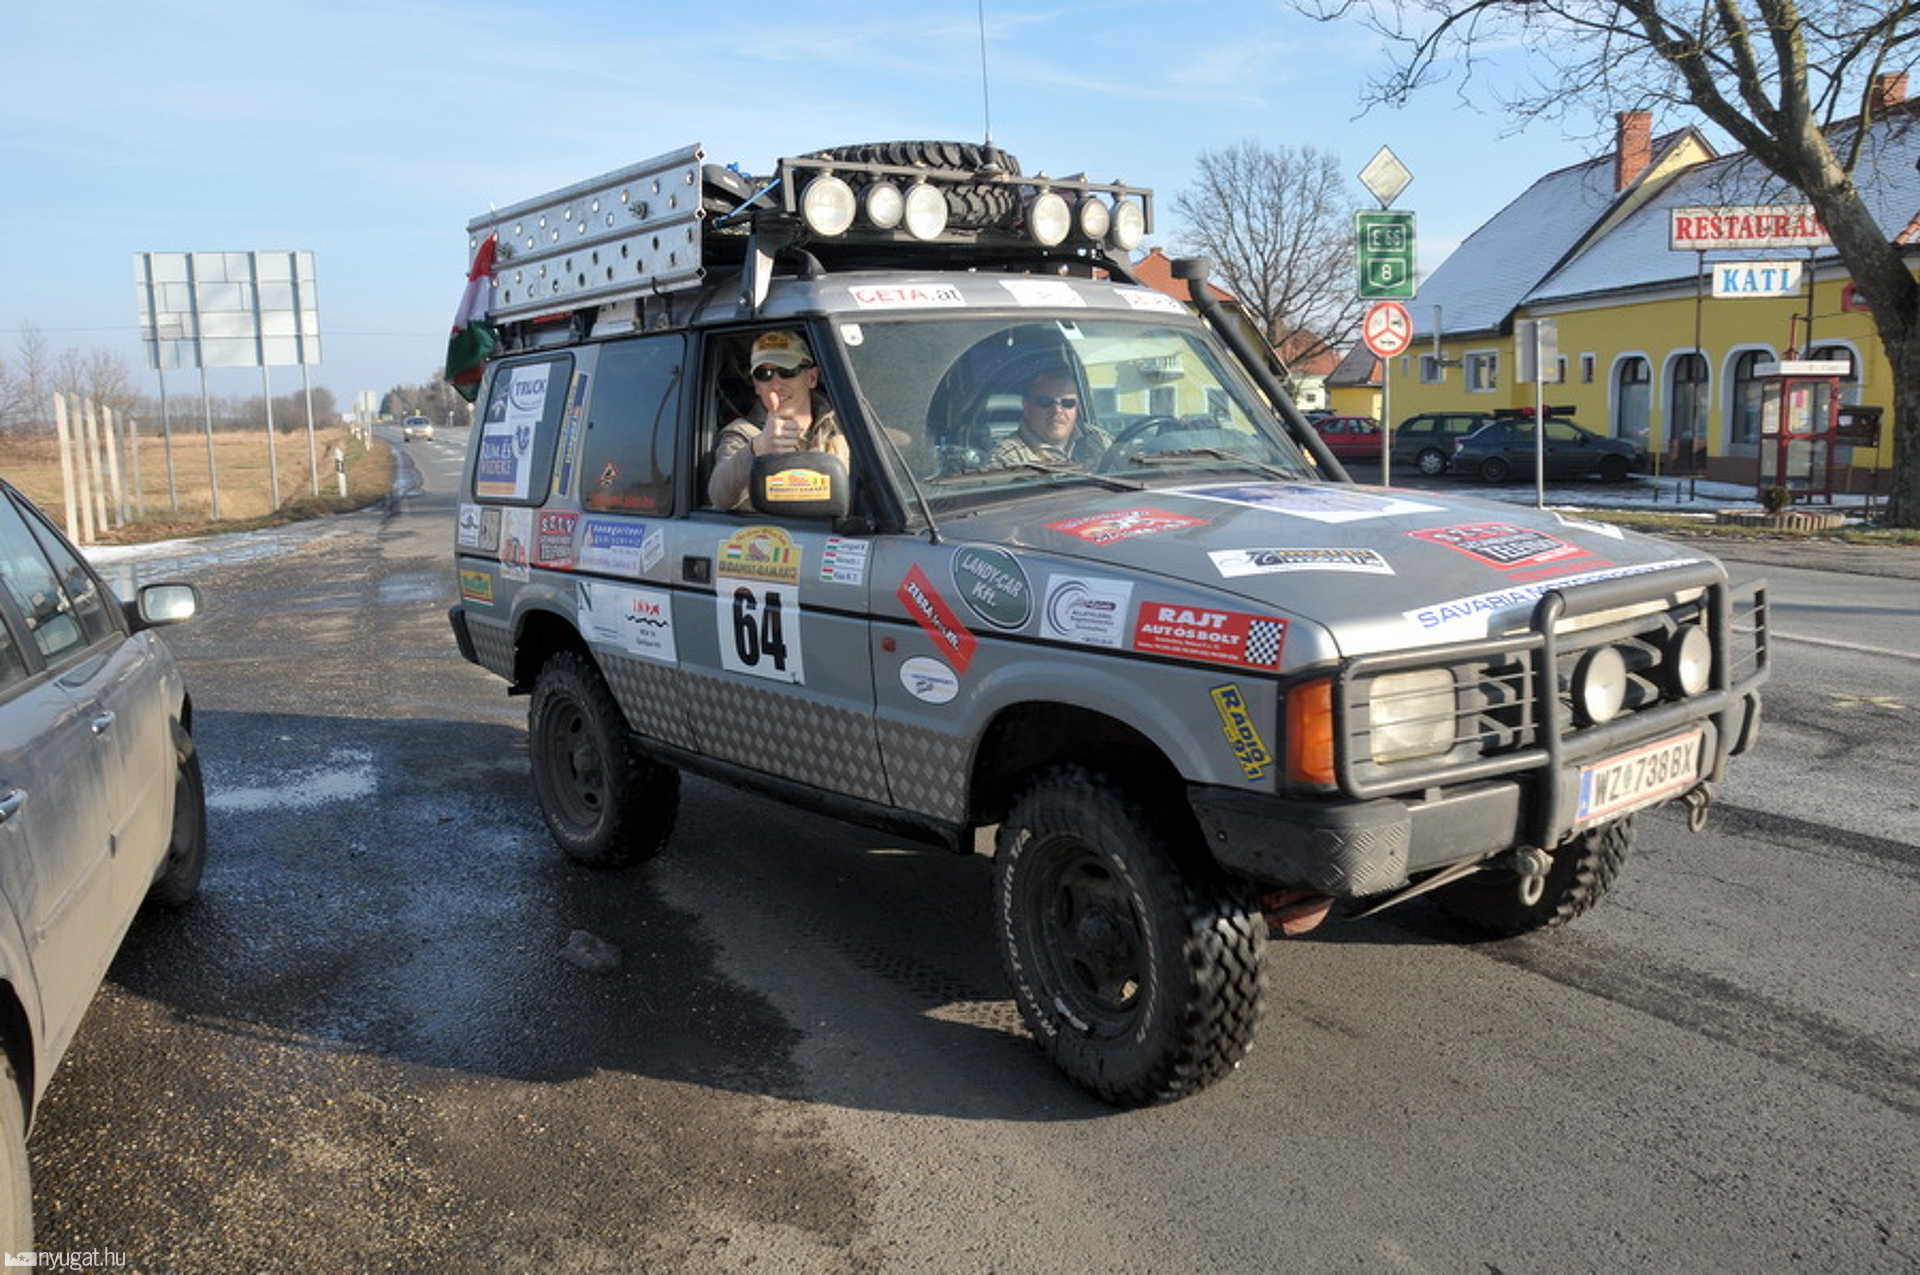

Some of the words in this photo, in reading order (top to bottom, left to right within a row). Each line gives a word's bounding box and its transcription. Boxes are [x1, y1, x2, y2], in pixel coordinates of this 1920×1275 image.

[1382, 263, 1392, 280] 8
[1722, 268, 1791, 293] KATI
[961, 553, 1023, 598] LANDY-CAR
[972, 581, 996, 607] Kft.
[1417, 589, 1530, 629] SAVARIA
[733, 586, 787, 671] 64
[1158, 607, 1228, 629] RAJT
[1594, 765, 1622, 806] WZ
[1633, 741, 1695, 793] 738BX
